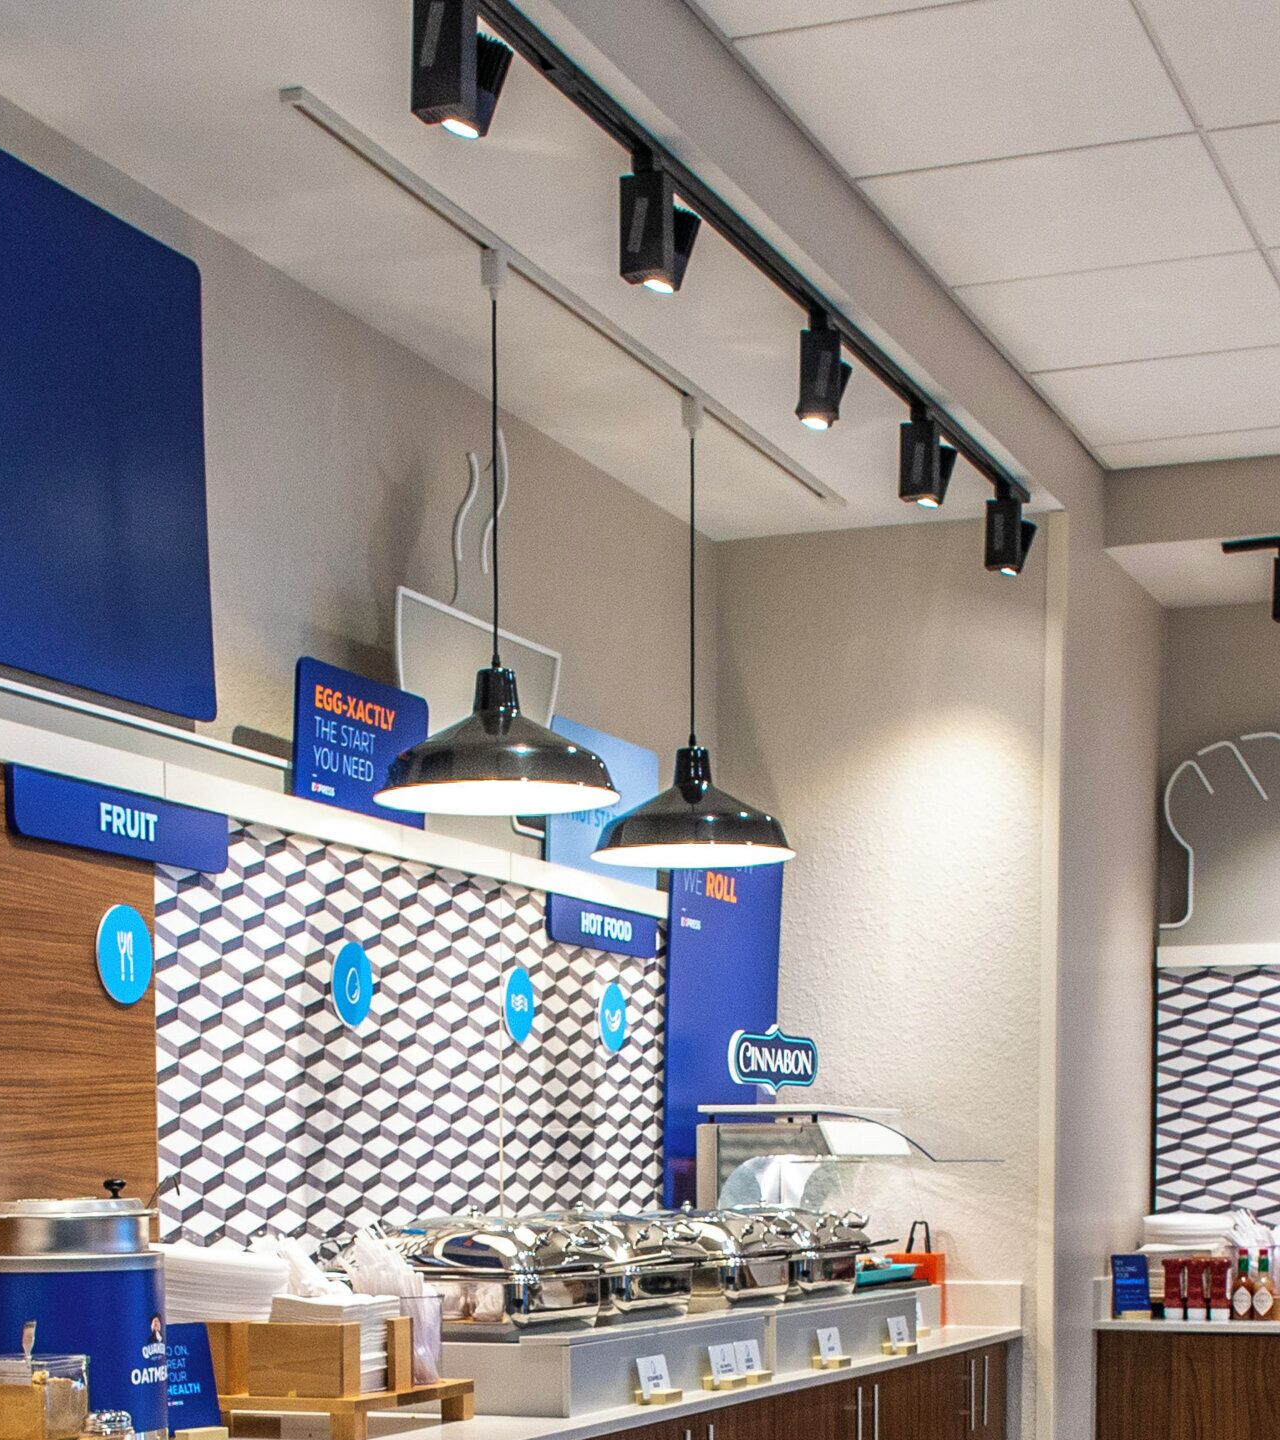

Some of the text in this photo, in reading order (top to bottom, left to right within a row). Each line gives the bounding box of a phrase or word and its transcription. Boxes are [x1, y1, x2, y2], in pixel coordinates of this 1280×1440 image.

[314, 684, 395, 731] EGG-XACTLY
[314, 716, 376, 755] THE START
[313, 747, 374, 782] YOU NEED
[99, 803, 158, 842] FRUIT
[684, 869, 737, 904] WE ROLL
[581, 911, 632, 942] HOT FOOD
[166, 1358, 186, 1369] REAT
[169, 1371, 187, 1383] OUR
